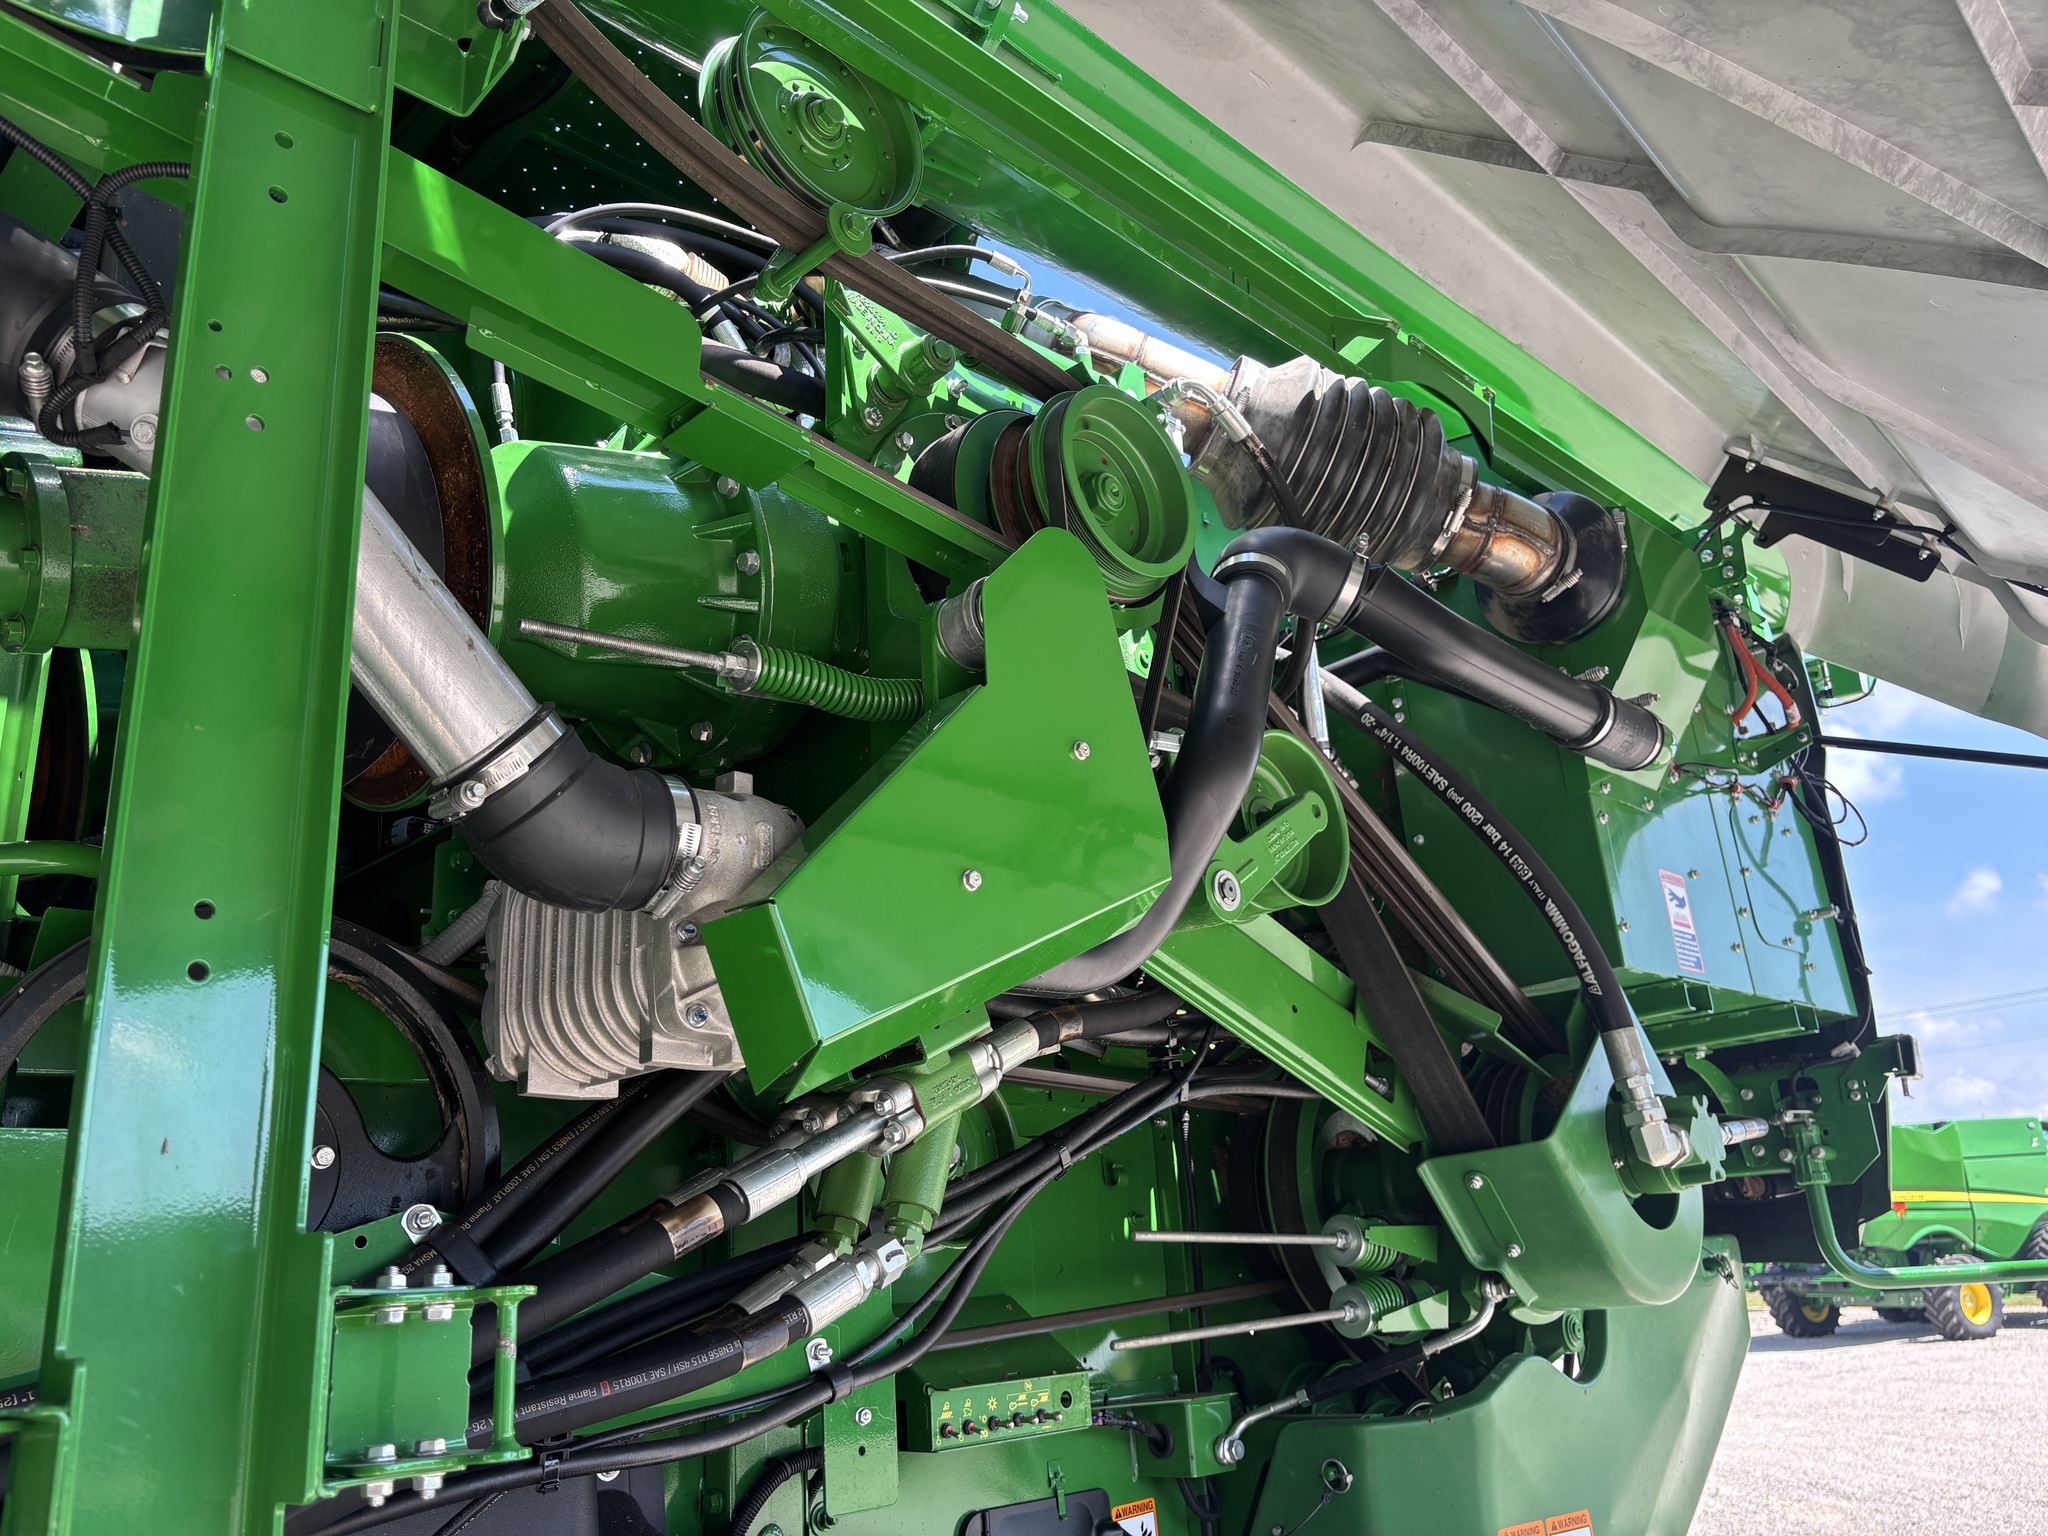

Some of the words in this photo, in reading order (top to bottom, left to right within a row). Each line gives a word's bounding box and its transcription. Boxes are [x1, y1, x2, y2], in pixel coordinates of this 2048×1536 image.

[1400, 744, 1449, 792] SAE100R4
[1446, 789, 1465, 805] psi)
[1461, 802, 1484, 826] (200
[1482, 823, 1502, 845] bar
[1498, 841, 1513, 858] 14
[1511, 857, 1530, 879] 604
[1529, 880, 1546, 900] ITALY
[1544, 898, 1597, 983] ALFAGOMMA
[577, 1114, 600, 1131] R1ATS
[552, 1132, 575, 1152] EN853
[538, 1149, 554, 1163] 1SN
[521, 1164, 536, 1178] SAE
[492, 1176, 523, 1204] 100R1AT
[469, 1203, 492, 1224] Flame
[412, 1249, 438, 1267] MSHA
[690, 1352, 707, 1365] R15
[706, 1342, 734, 1360] EN856
[648, 1365, 666, 1380] SAE
[671, 1358, 690, 1373] 4SH
[611, 1371, 648, 1391] 100R15
[566, 1386, 597, 1402] Flame
[519, 1394, 567, 1416] Resistant
[1121, 1499, 1153, 1516] WARNING
[1557, 1514, 1588, 1529] WARNING
